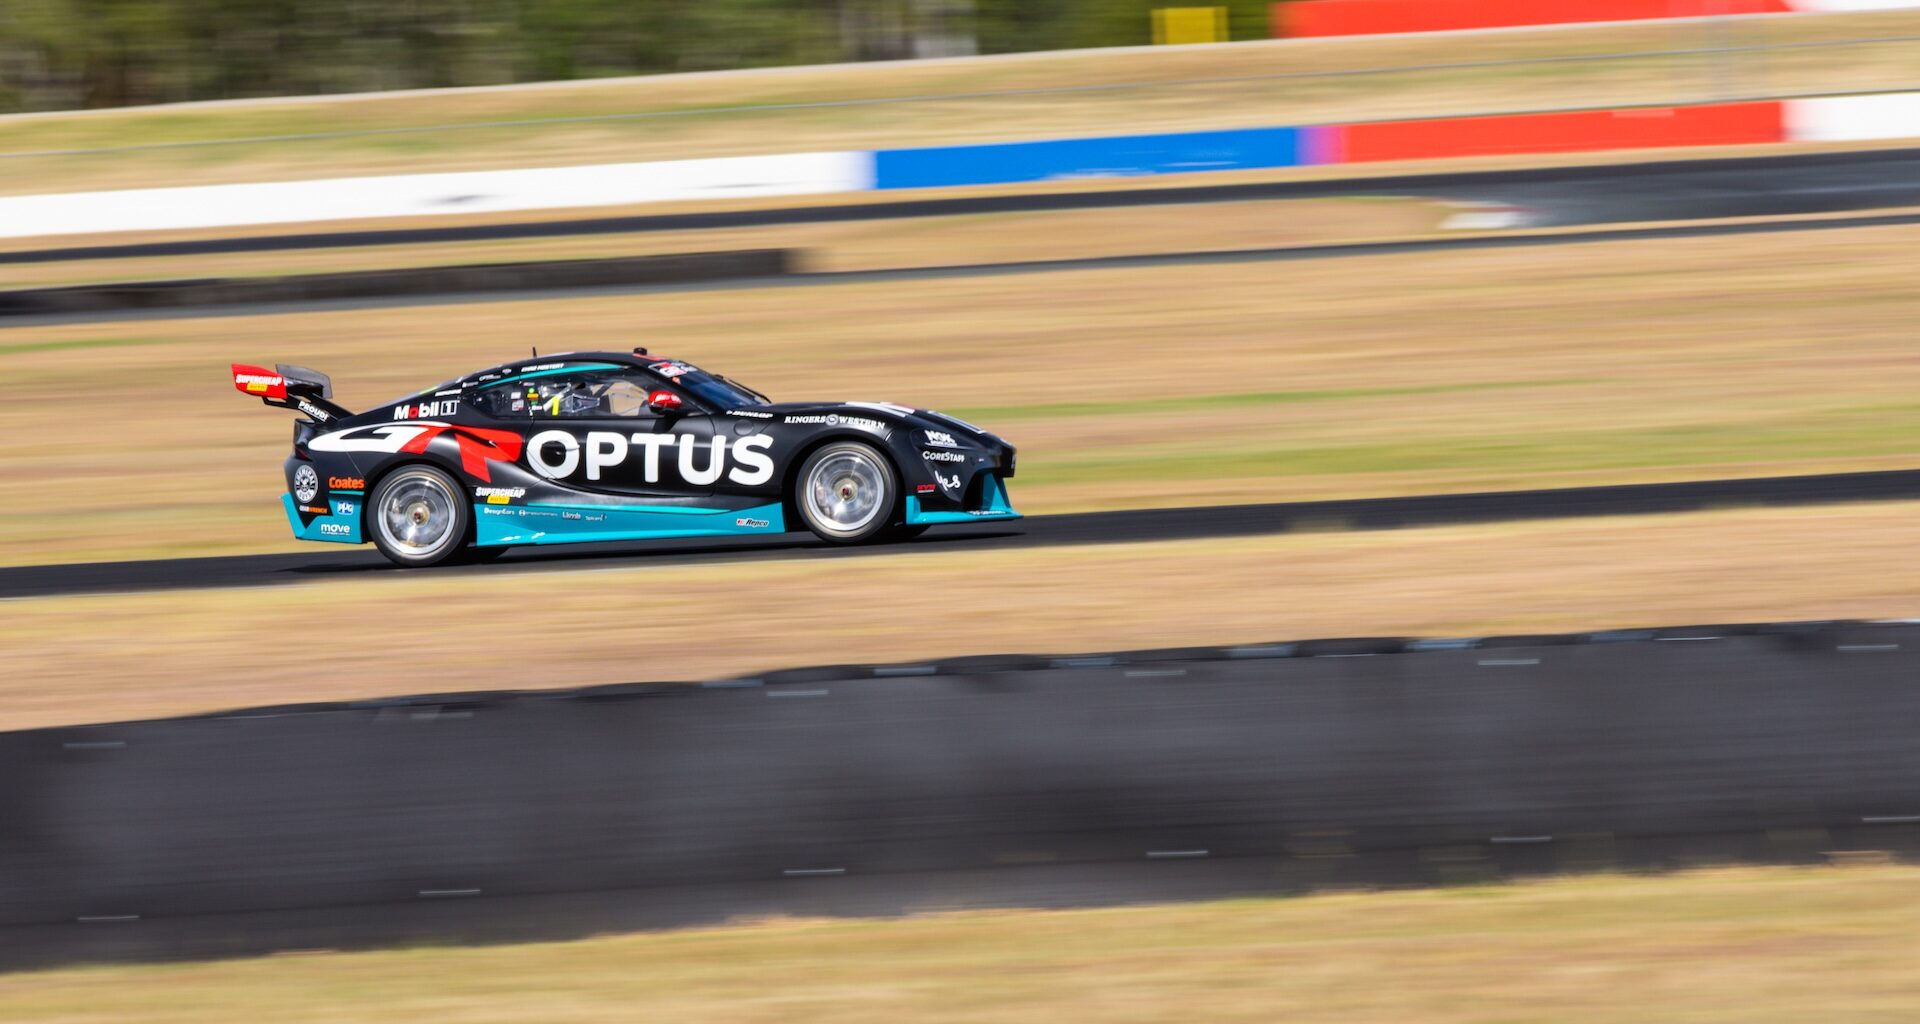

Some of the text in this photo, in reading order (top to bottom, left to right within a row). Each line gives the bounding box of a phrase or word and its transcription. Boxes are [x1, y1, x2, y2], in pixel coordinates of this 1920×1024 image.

[235, 374, 282, 386] SUPERCHEAP
[394, 402, 438, 420] Mobil
[784, 415, 886, 430] RINGERS WESTERN
[527, 430, 775, 486] OPTUS
[329, 476, 365, 488] Coates
[476, 487, 526, 498] SUPERCHEAP
[321, 523, 350, 533] move
[745, 519, 768, 527] Repco
